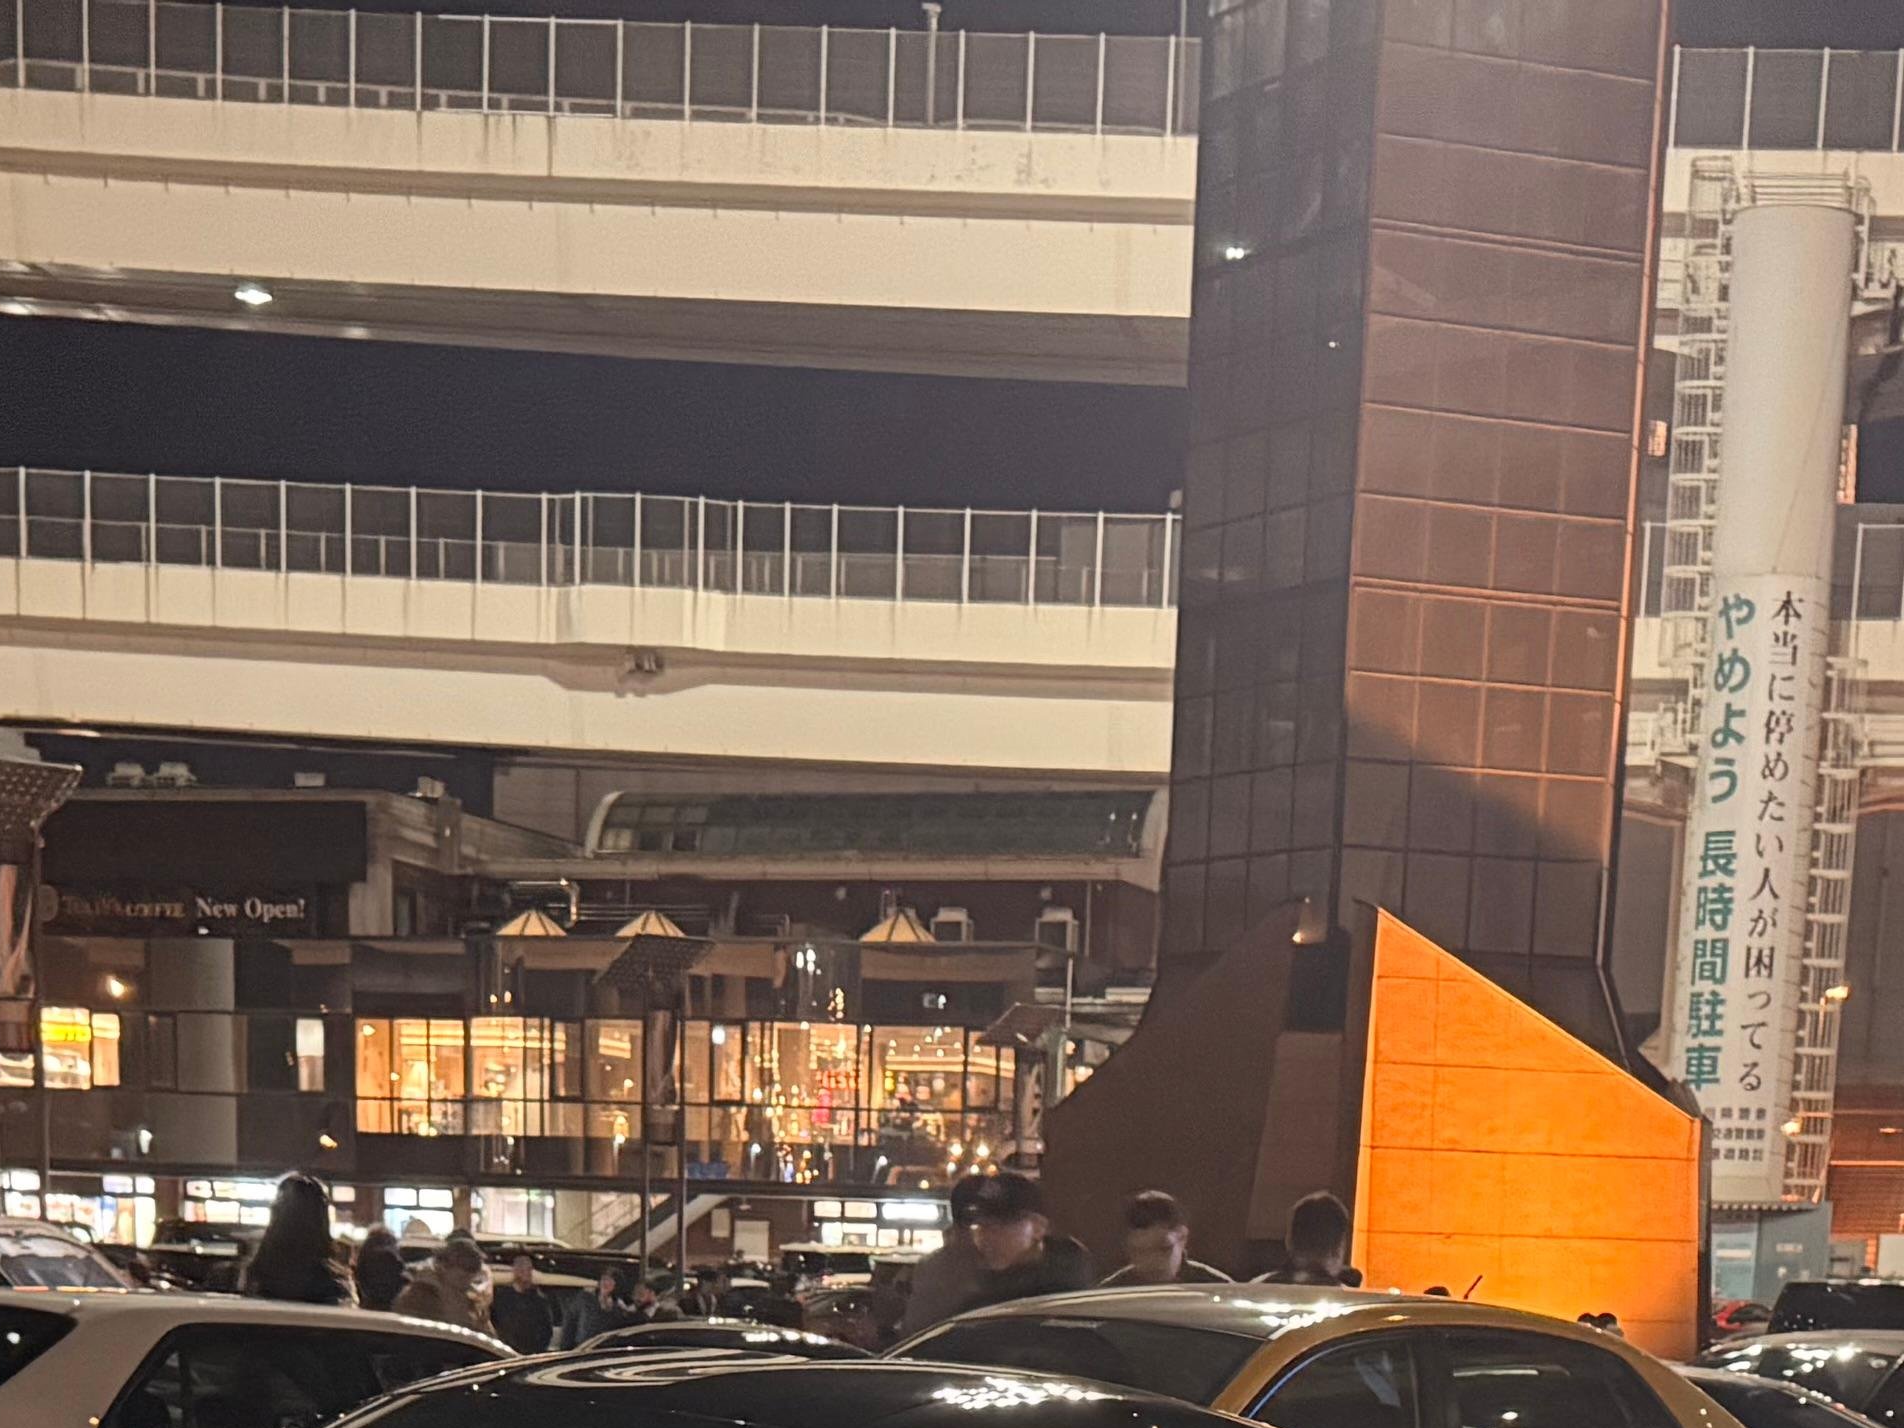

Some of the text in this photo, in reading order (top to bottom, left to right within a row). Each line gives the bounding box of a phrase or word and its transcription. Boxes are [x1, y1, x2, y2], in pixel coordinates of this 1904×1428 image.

[1708, 592, 1756, 805] やめよう
[195, 896, 238, 918] New
[244, 897, 306, 923] Open!
[1739, 590, 1804, 1092] 本当に停めたい人が困ってる
[1684, 830, 1738, 1092] 長時間駐車
